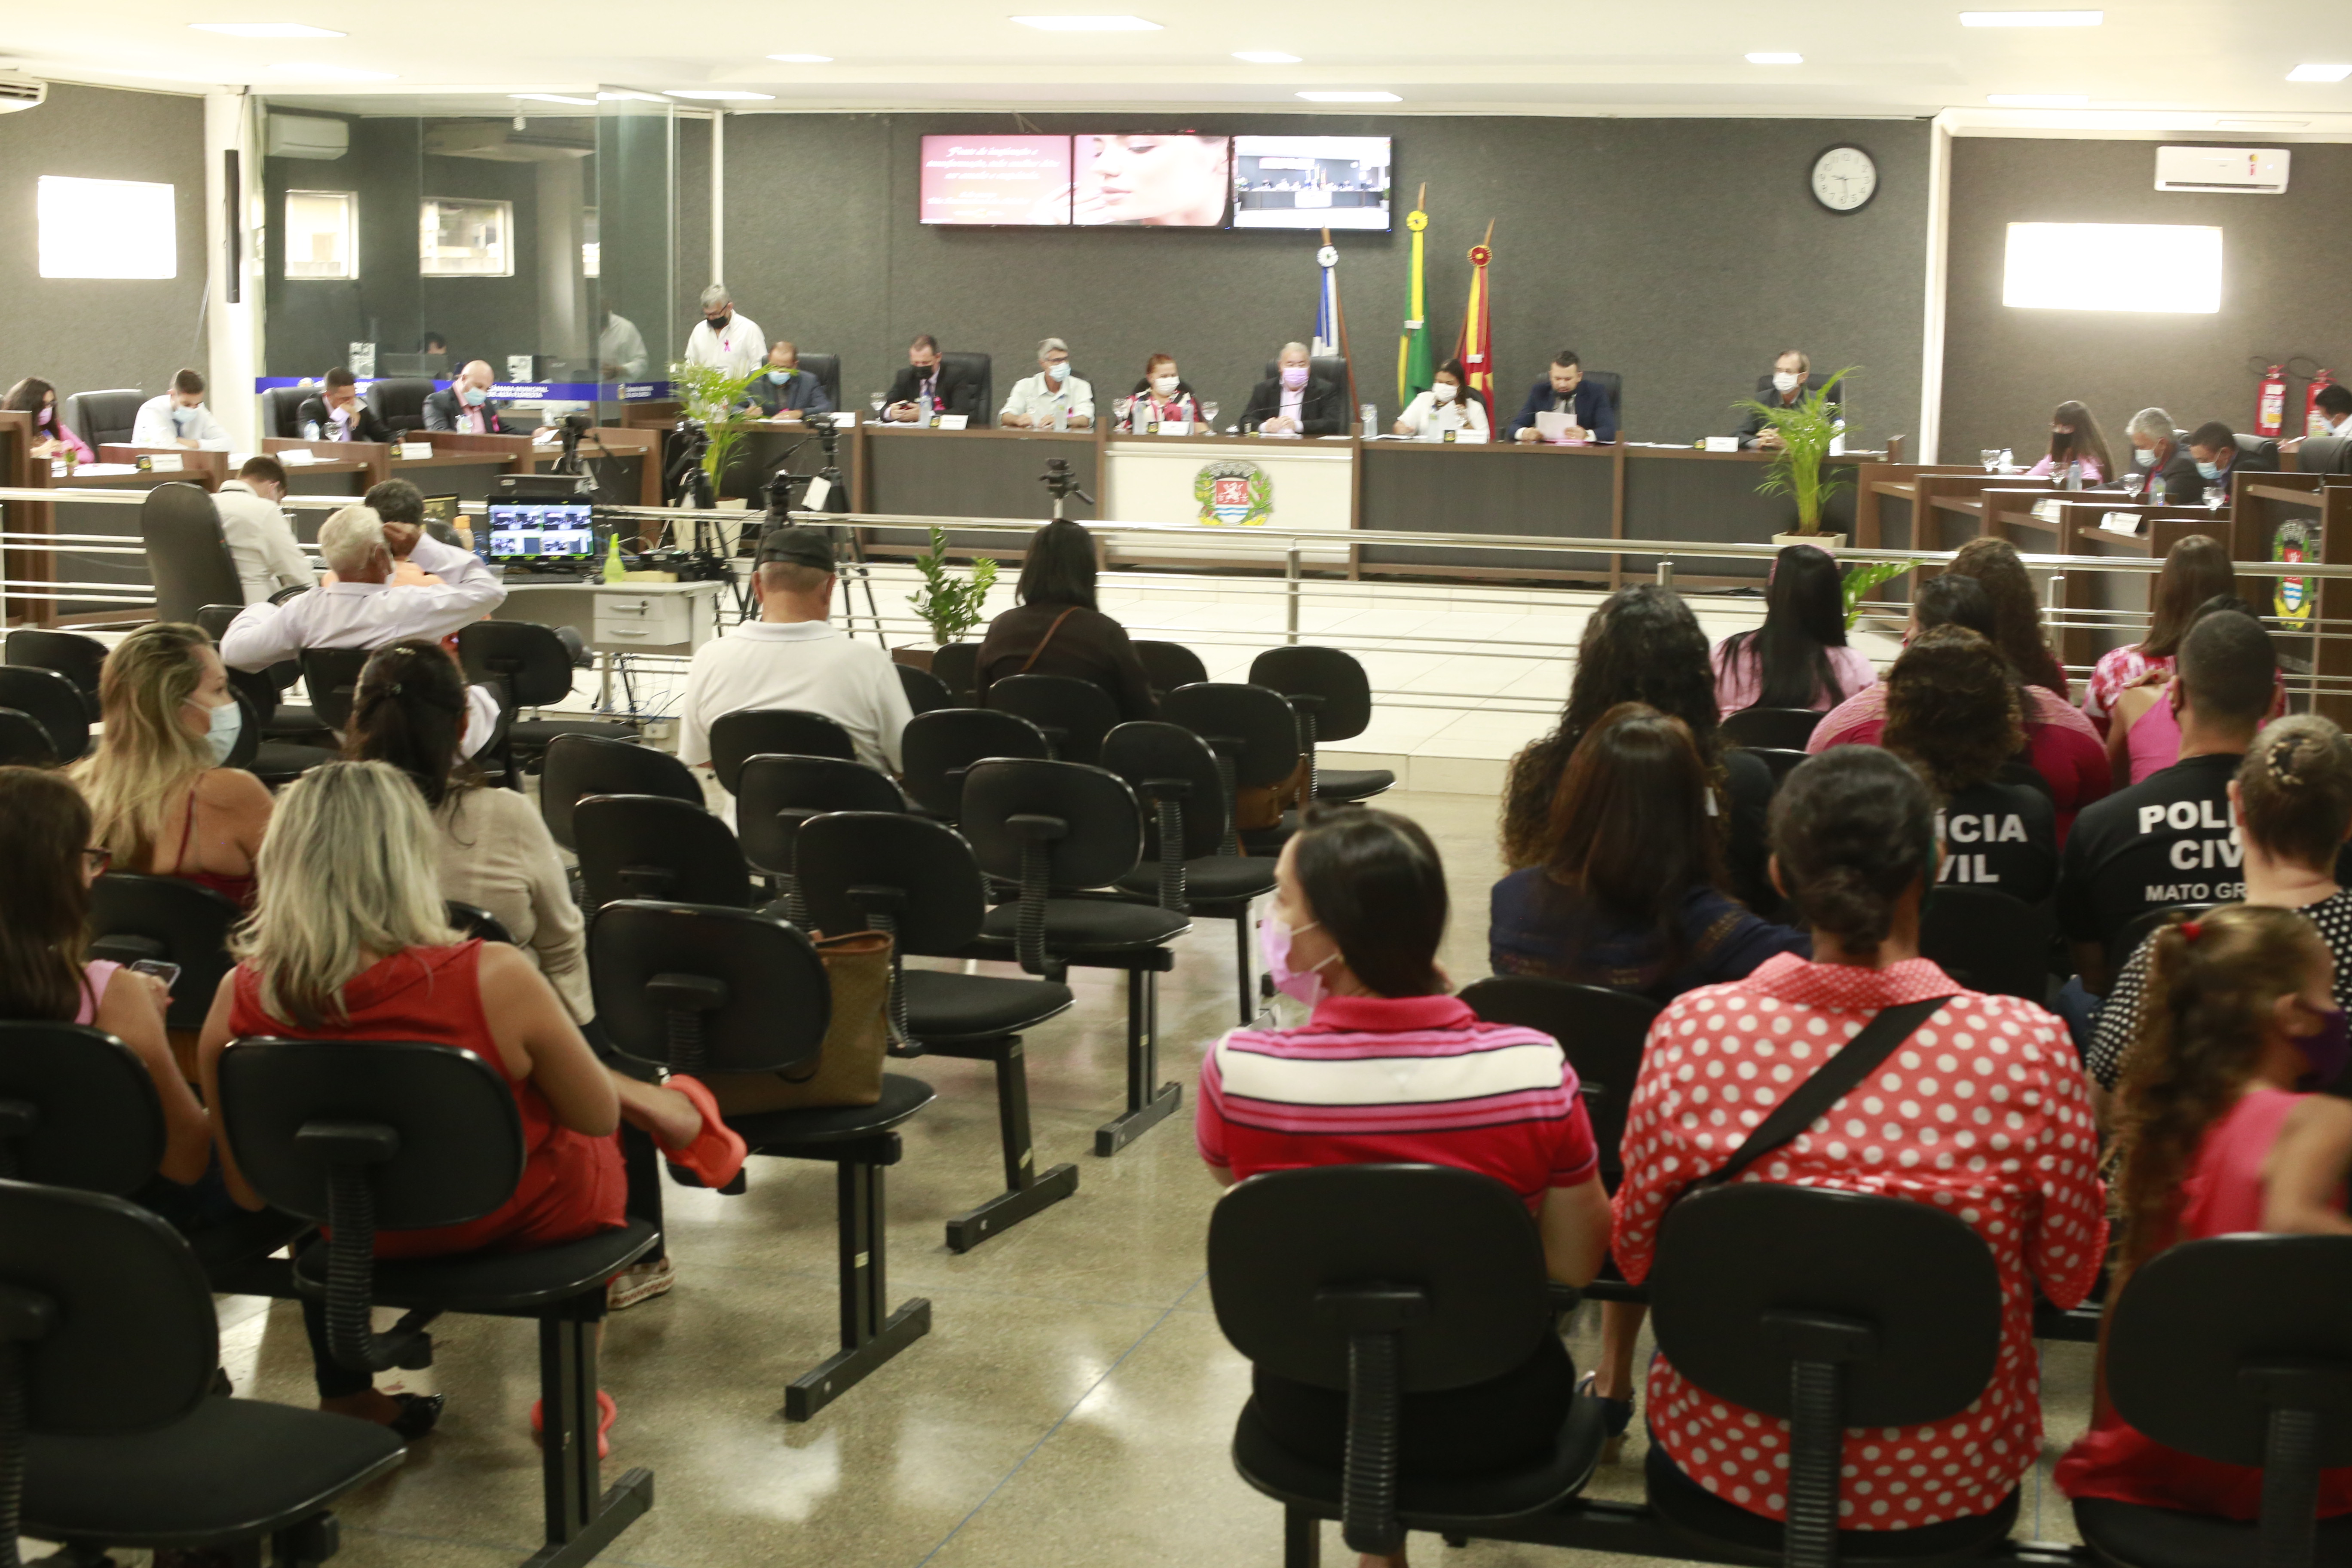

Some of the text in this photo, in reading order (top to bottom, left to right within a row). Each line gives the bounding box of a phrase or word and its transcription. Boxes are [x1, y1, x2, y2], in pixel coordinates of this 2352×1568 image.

[1935, 807, 2028, 842] ÍCIA
[2138, 800, 2236, 834] POLI
[2169, 839, 2244, 870] CIV
[2145, 883, 2210, 901] MATO
